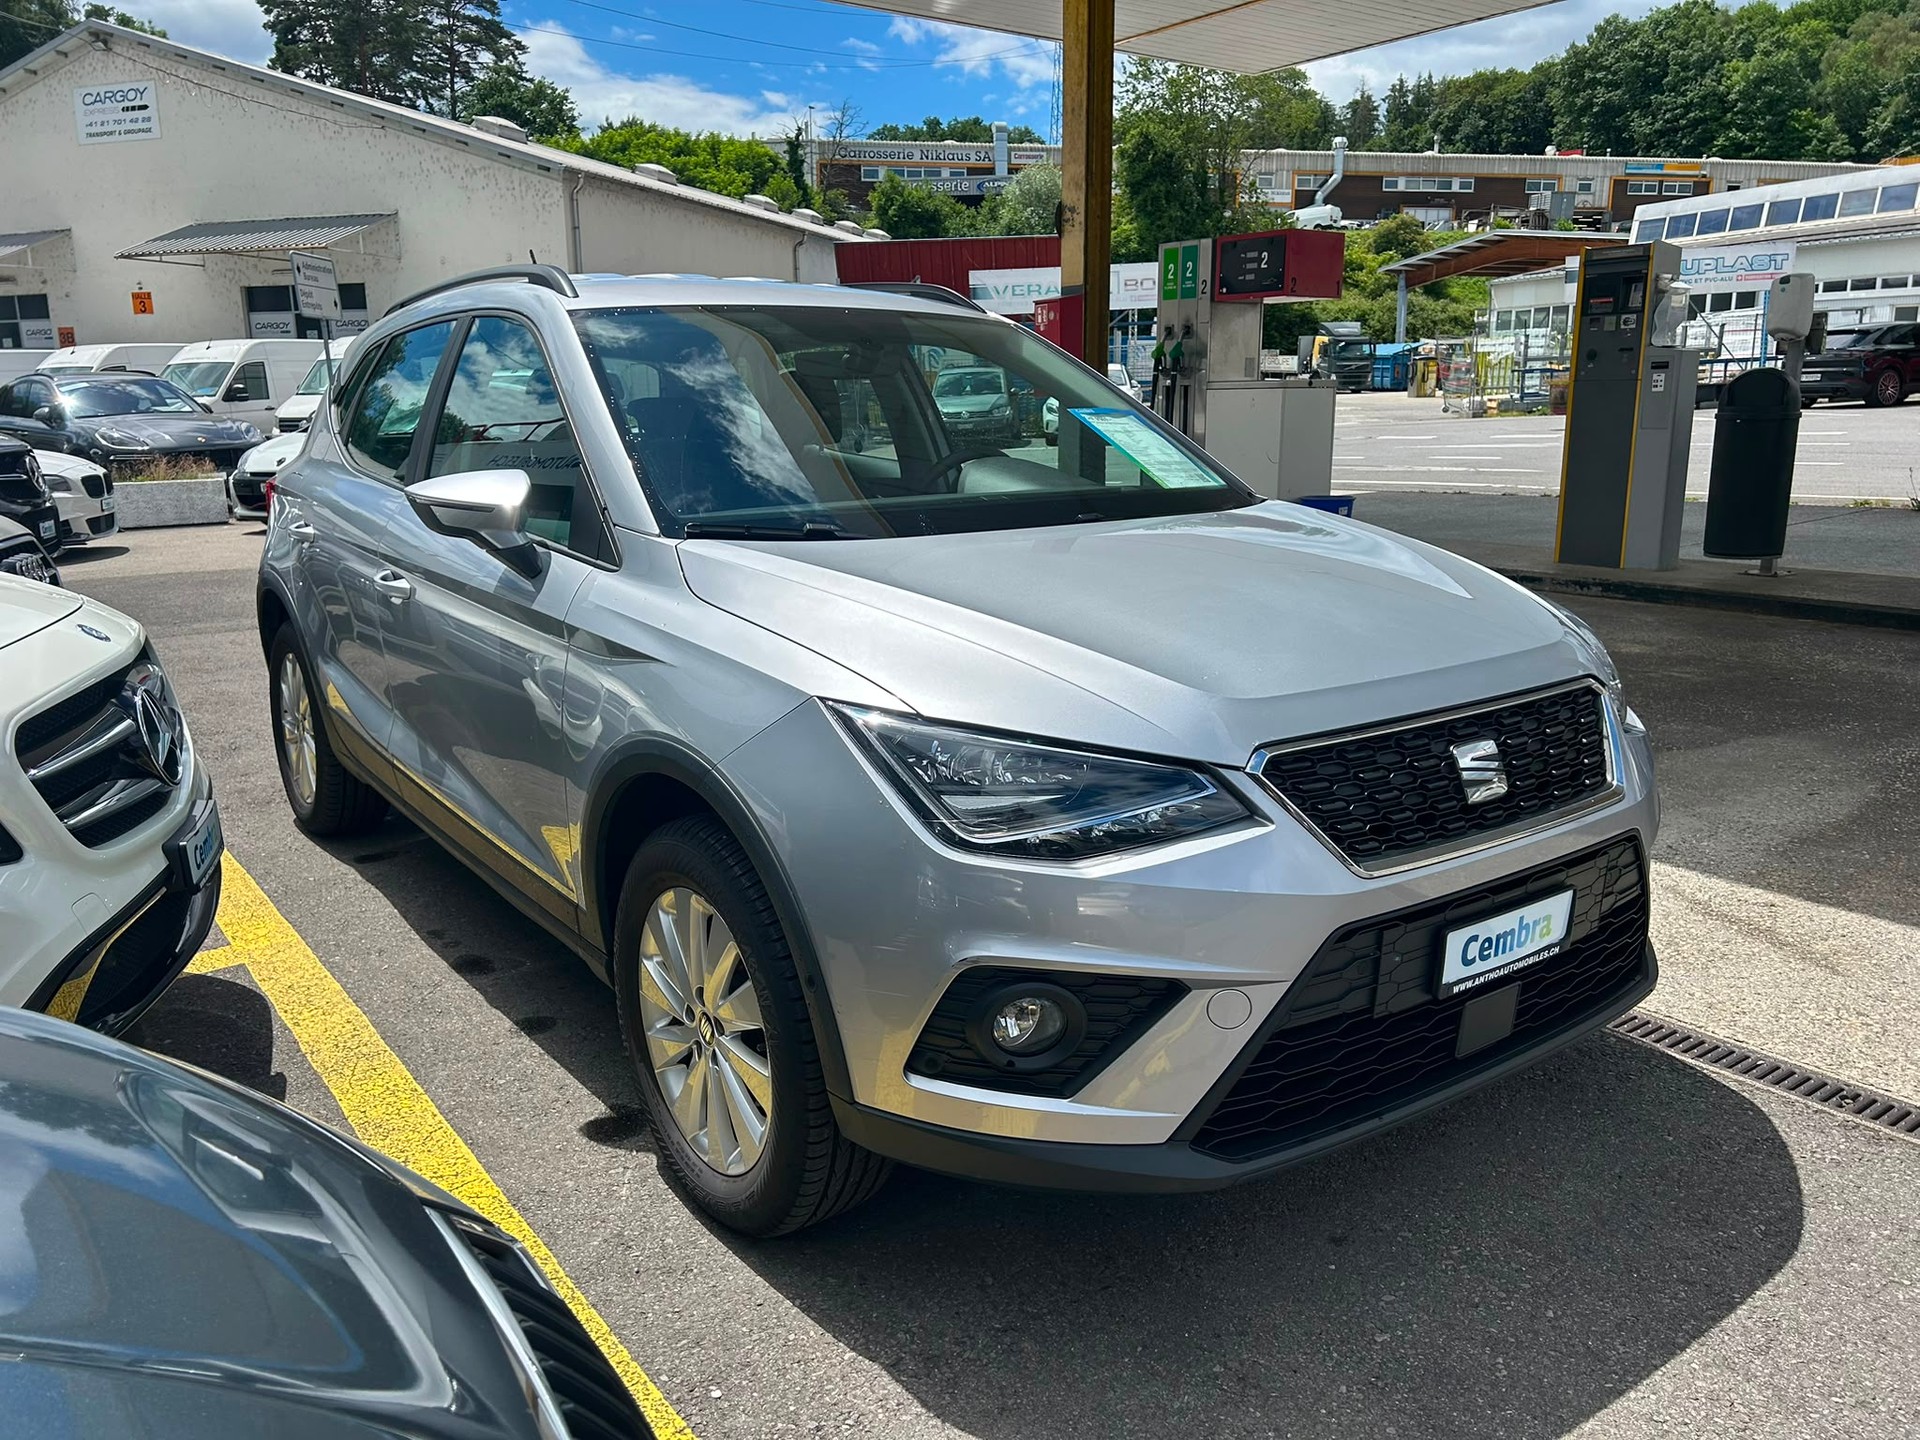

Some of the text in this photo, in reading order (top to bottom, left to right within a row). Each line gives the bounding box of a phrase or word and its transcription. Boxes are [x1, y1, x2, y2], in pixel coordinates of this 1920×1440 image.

[82, 87, 148, 106] CARGOY
[86, 130, 117, 139] TRANSPORT
[123, 127, 152, 135] GROUPAGE
[838, 146, 992, 162] Carrosserie Niklaus SA
[1260, 251, 1268, 269] 2
[1679, 253, 1789, 276] UPLAST
[1168, 263, 1175, 279] 2
[1186, 261, 1193, 277] 2
[1201, 279, 1207, 295] 2
[1290, 277, 1297, 293] 2
[139, 300, 147, 313] 3
[255, 322, 290, 330] CARGOY
[60, 332, 75, 345] 3B
[1460, 914, 1553, 968] Cembra
[1453, 945, 1560, 994] WWW.ANTHOAUTOMOBILES.CH
